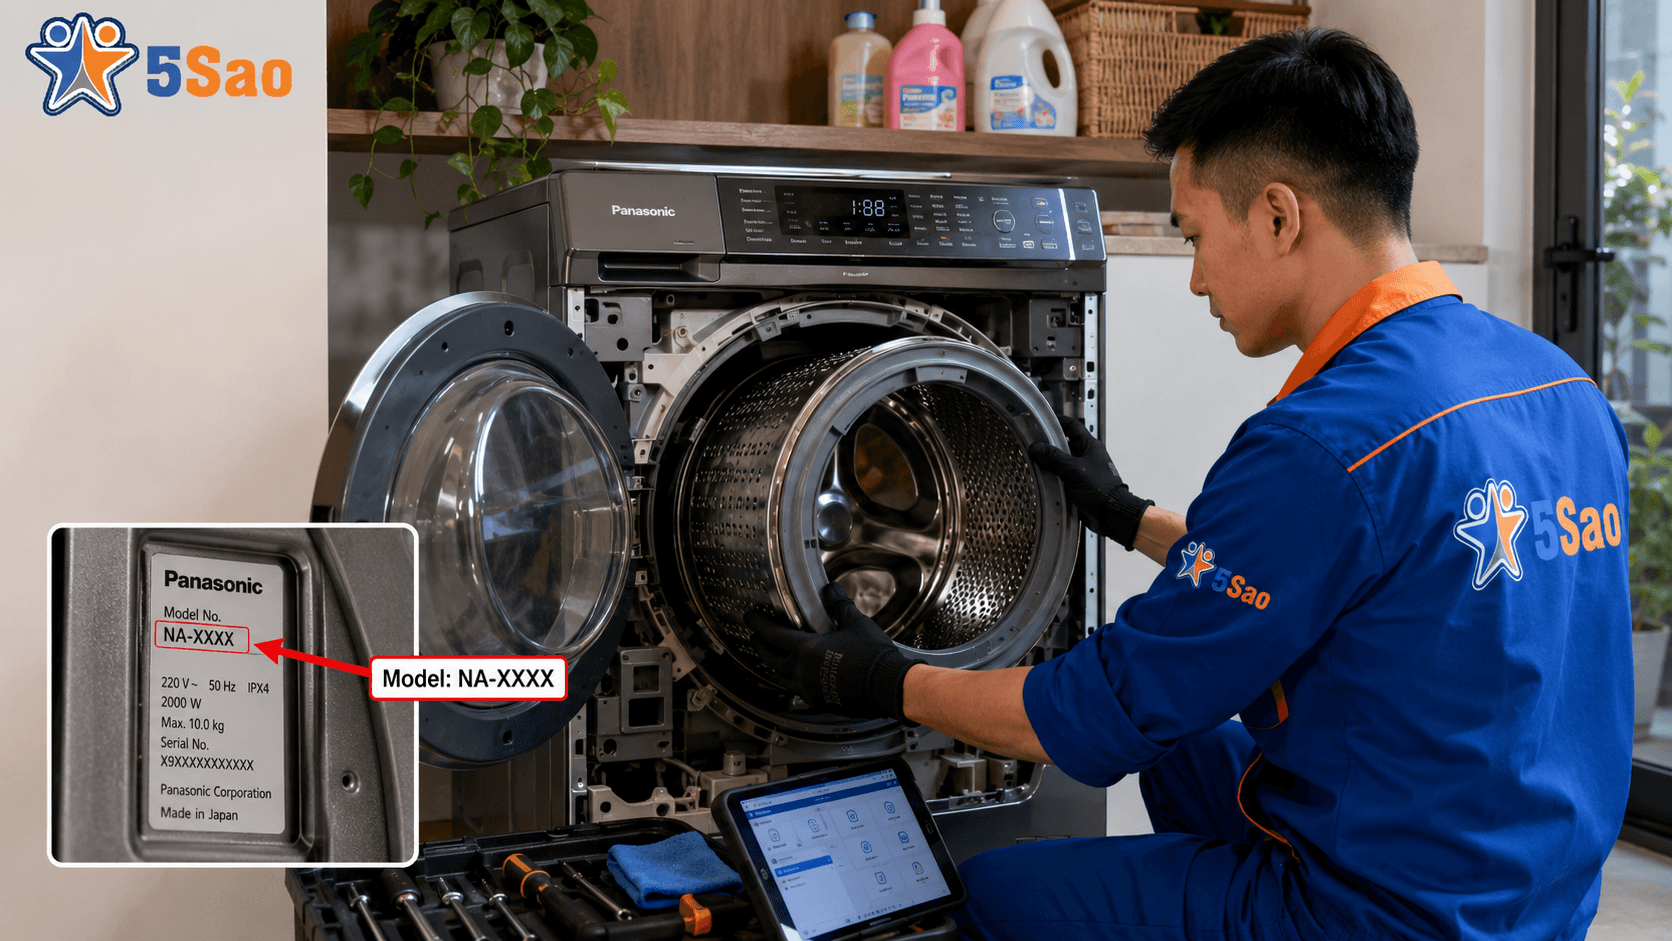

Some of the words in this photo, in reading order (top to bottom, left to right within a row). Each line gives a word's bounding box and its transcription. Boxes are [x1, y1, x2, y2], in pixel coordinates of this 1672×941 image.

[611, 205, 675, 217] Panasonic
[1530, 495, 1622, 562] 5Sao
[165, 570, 263, 594] Panasonic
[1211, 566, 1271, 611] 5Sao
[164, 606, 198, 620] Model
[203, 609, 221, 622] No.
[164, 627, 234, 646] NA-XXXX
[162, 677, 179, 688] 220
[209, 680, 220, 691] 50
[224, 681, 235, 692] Hz
[248, 682, 269, 694] IPX4
[162, 696, 186, 708] 2000
[190, 698, 201, 709] W
[162, 717, 185, 728] Max.
[189, 718, 209, 730] 10.0
[213, 719, 224, 734] kg
[161, 736, 188, 749] Serial
[192, 738, 209, 750] No.
[161, 784, 210, 796] Panasonic
[214, 786, 271, 800] Corporation
[161, 807, 191, 819] Made
[196, 808, 204, 819] in
[209, 809, 238, 822] Japan
